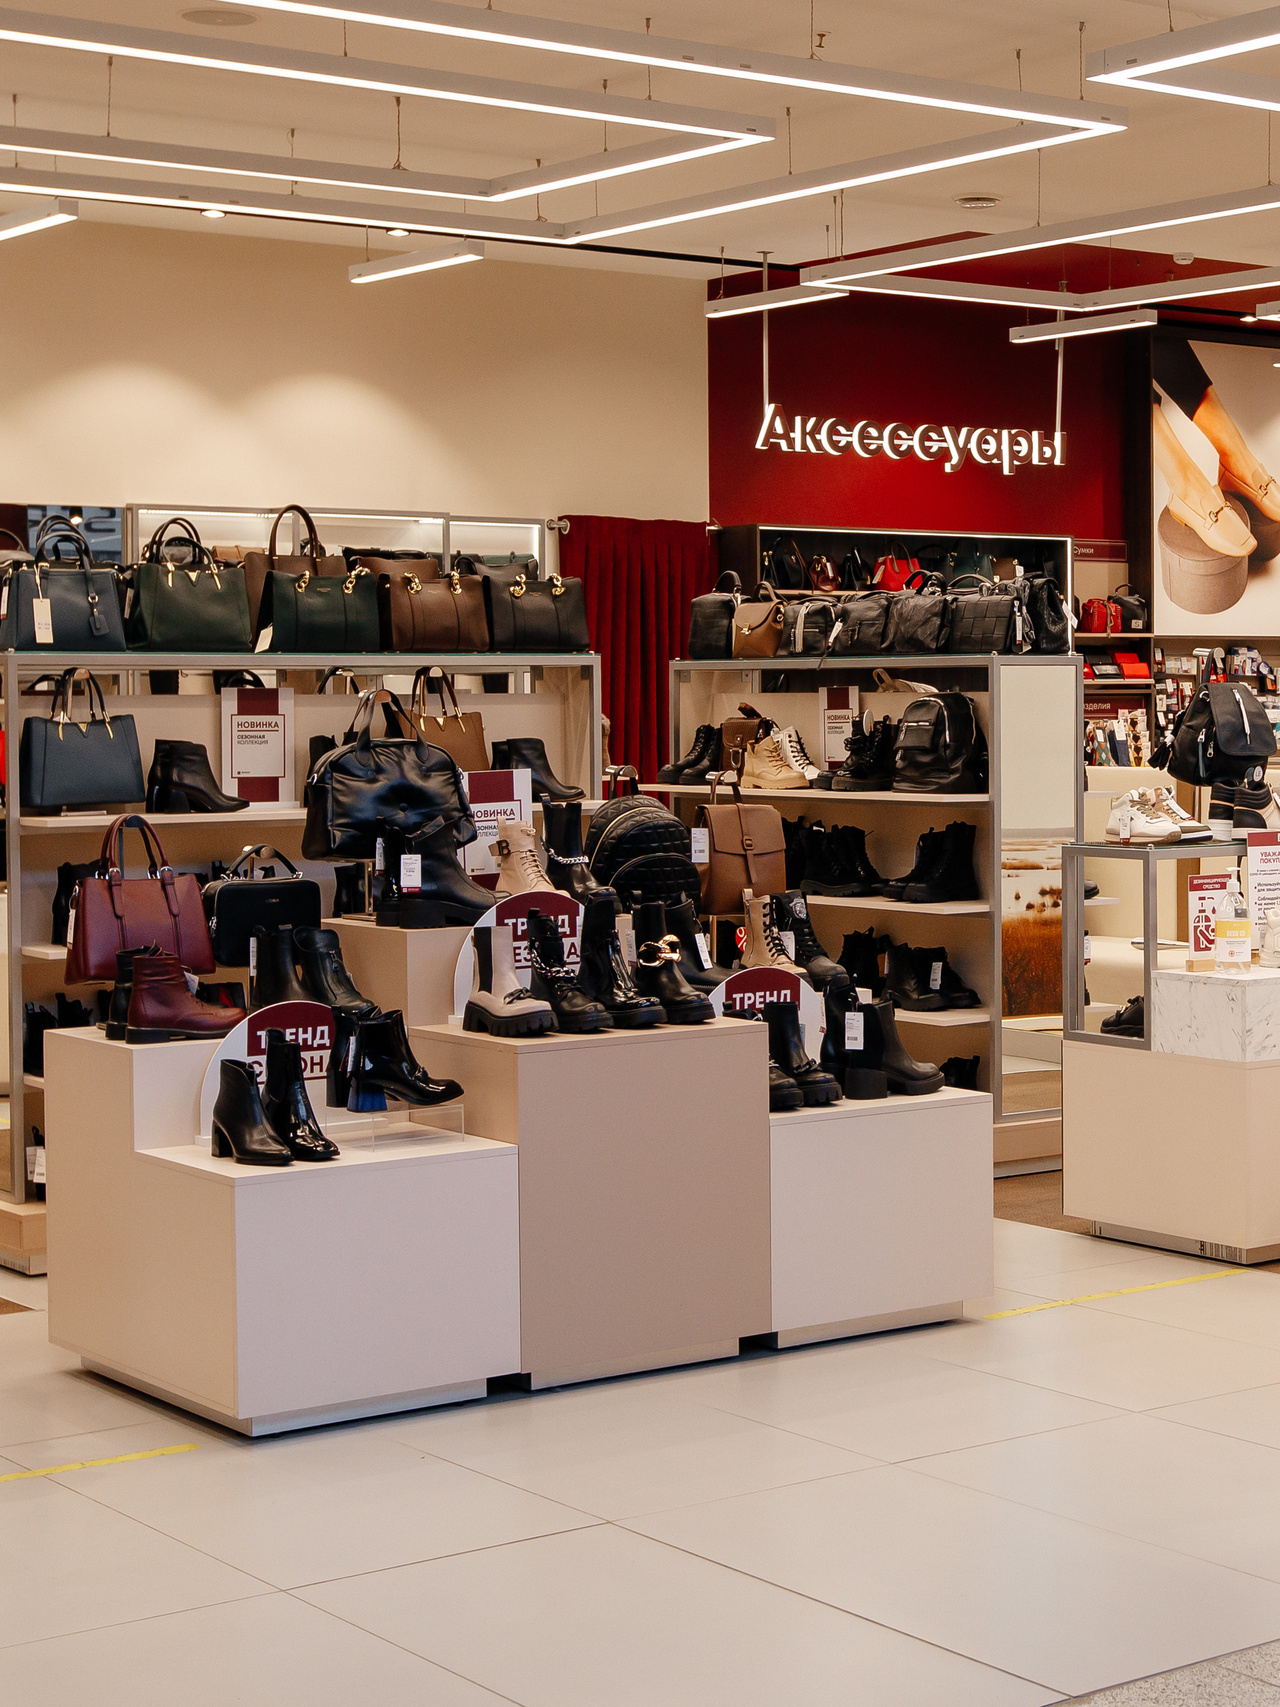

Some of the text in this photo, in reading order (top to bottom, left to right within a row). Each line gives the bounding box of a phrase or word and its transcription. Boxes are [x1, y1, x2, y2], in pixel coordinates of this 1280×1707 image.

[755, 403, 1066, 475] Аксессуары
[1074, 546, 1094, 555] Сумки
[237, 721, 279, 729] НОВИНКА
[504, 915, 570, 935] ТРД
[257, 1025, 330, 1049] ТЕНД
